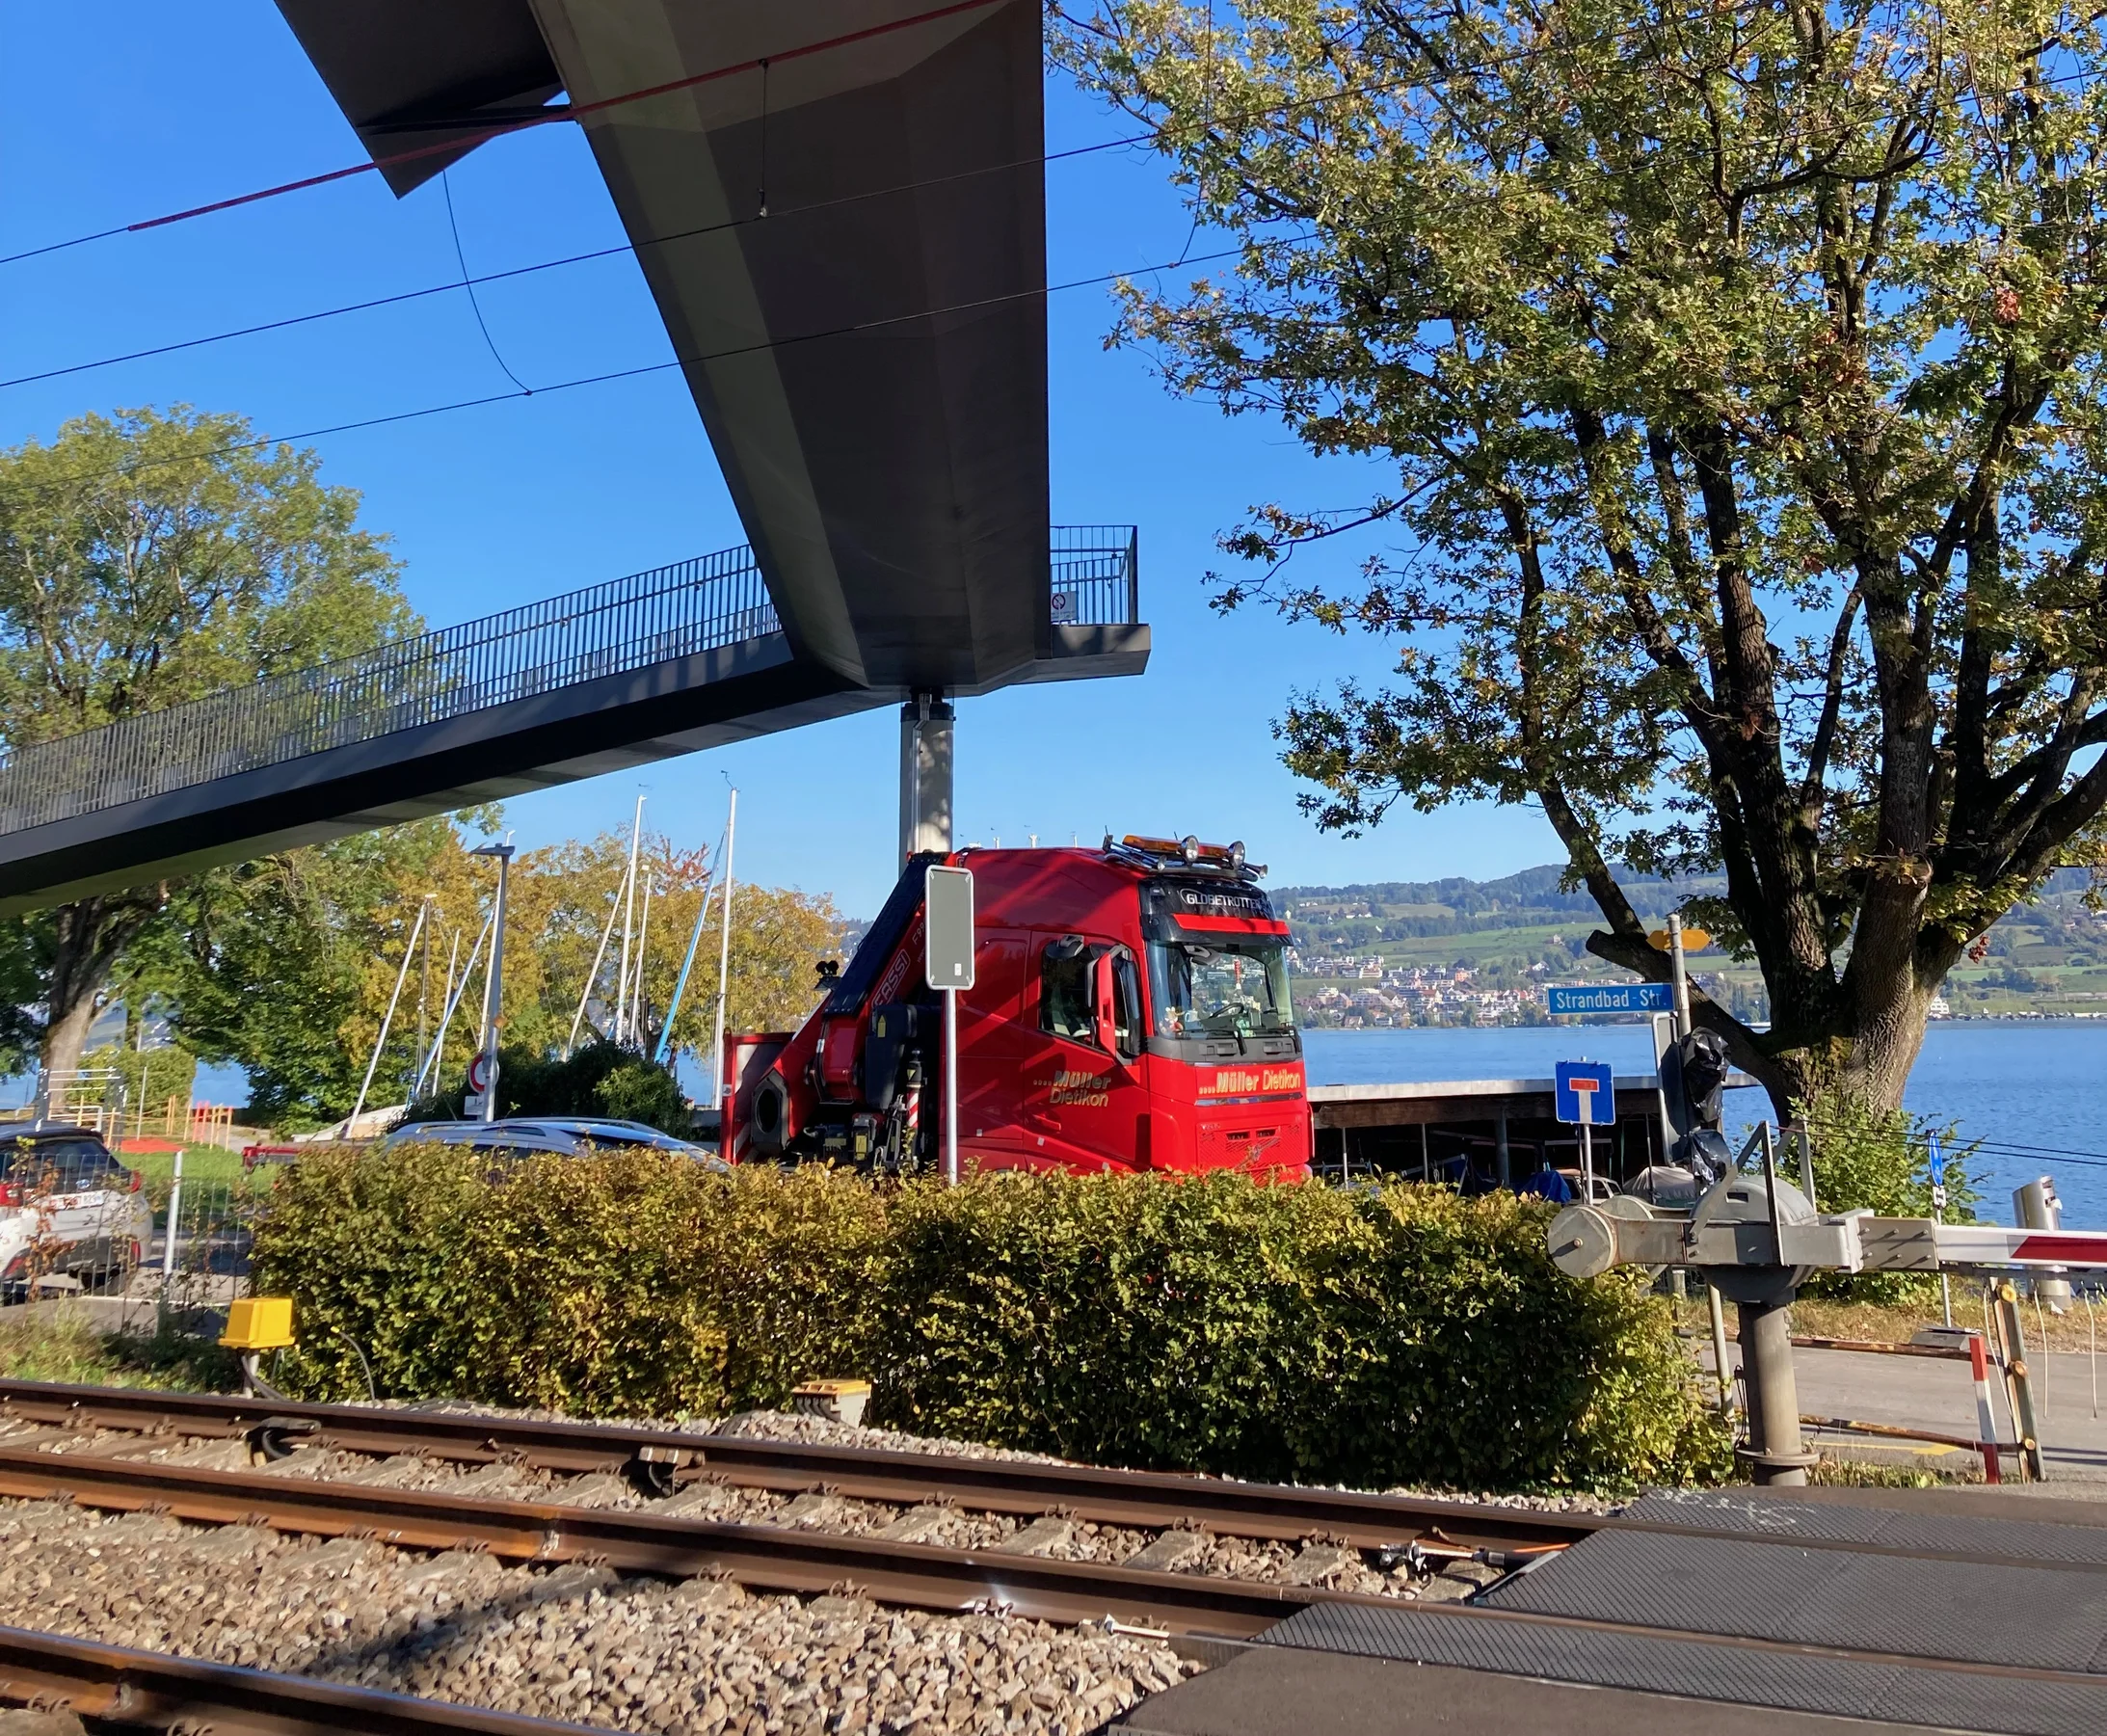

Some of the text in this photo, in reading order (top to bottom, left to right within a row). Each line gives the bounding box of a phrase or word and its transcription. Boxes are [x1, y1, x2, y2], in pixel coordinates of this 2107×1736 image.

[1187, 893, 1262, 910] GLOBETROTTER
[874, 953, 908, 1005] FASSI
[1263, 1069, 1301, 1090] Dietikon
[1050, 1087, 1109, 1108] Dietikon
